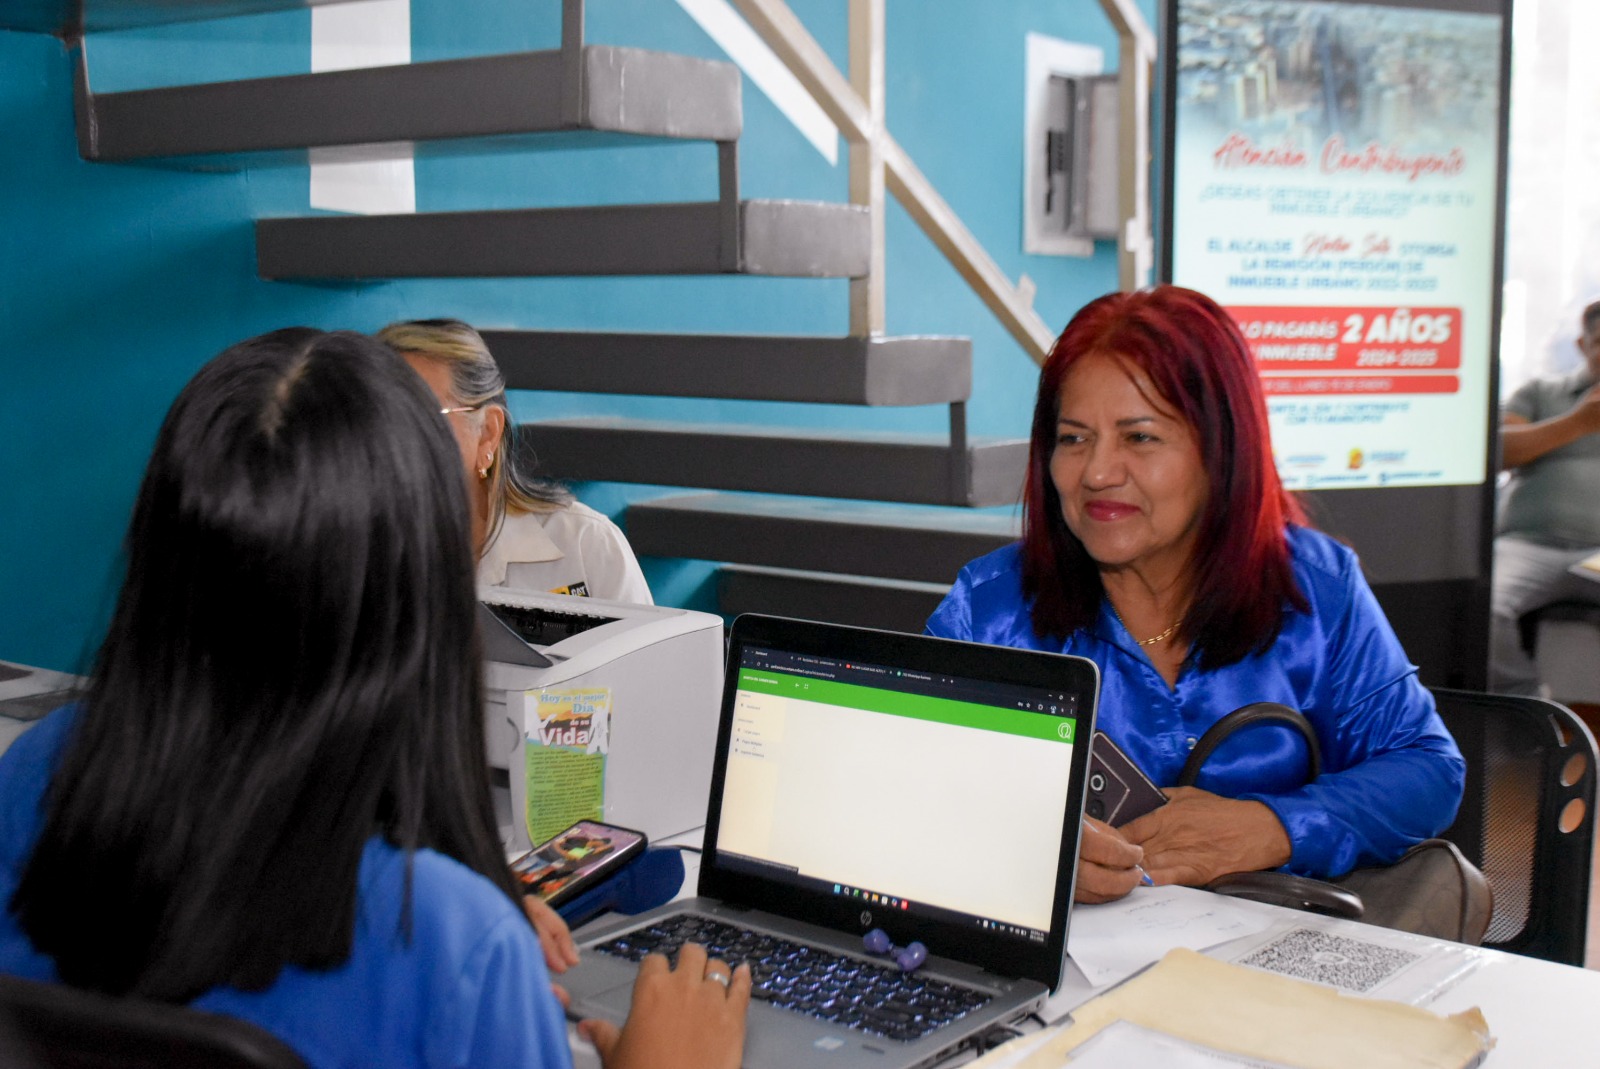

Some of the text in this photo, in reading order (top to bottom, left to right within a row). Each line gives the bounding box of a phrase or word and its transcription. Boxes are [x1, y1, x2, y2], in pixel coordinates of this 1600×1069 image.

[1229, 238, 1291, 253] ALCALDE
[1228, 275, 1299, 289] INMUEBLE
[1342, 306, 1453, 344] 2 AÑOS
[1258, 342, 1338, 361] INMUEBLE
[571, 585, 586, 596] CAT
[541, 694, 561, 704] Hoy
[583, 694, 606, 704] mejor
[572, 701, 595, 714] Día
[569, 718, 580, 726] de
[538, 727, 590, 746] Vida
